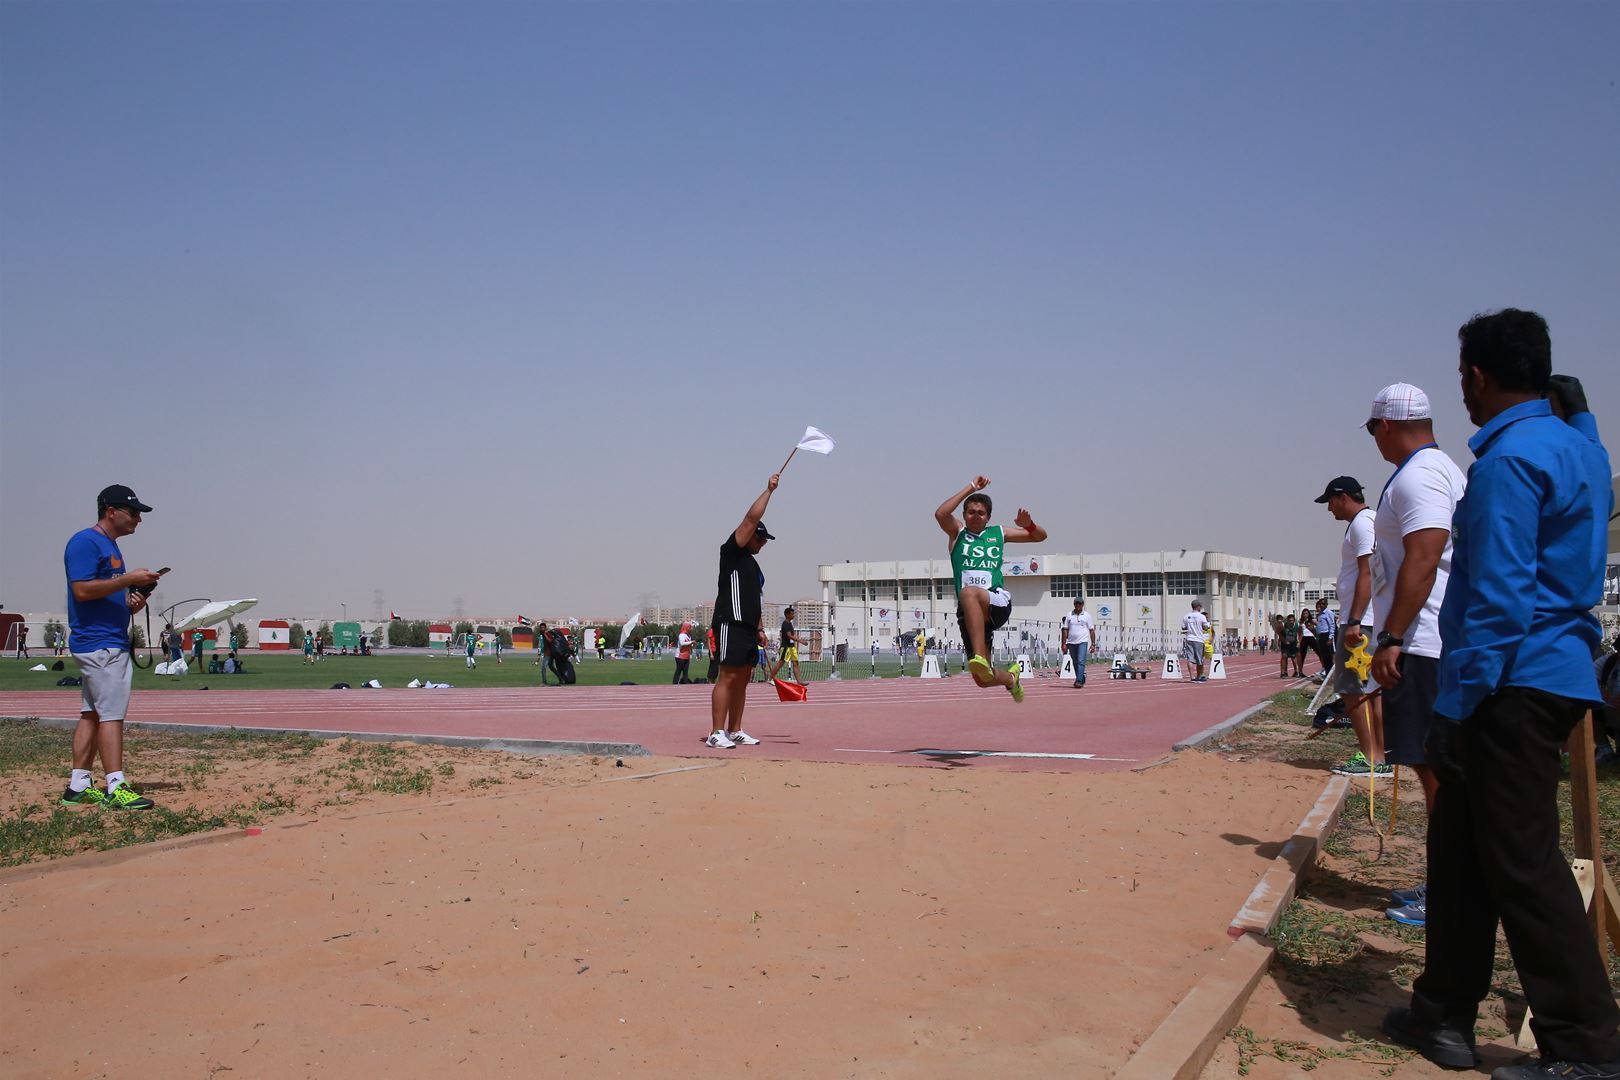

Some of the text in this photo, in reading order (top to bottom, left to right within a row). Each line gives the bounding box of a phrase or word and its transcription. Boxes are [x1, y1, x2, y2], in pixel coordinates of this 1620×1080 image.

[961, 543, 1000, 559] ISC
[962, 558, 976, 568] AL
[978, 560, 999, 569] AIN
[968, 576, 987, 585] 386
[926, 660, 930, 673] 1
[1019, 660, 1025, 673] 3
[1064, 660, 1071, 673] 4
[1115, 660, 1122, 669] 5
[1166, 660, 1174, 673] 6
[1213, 660, 1221, 673] 7
